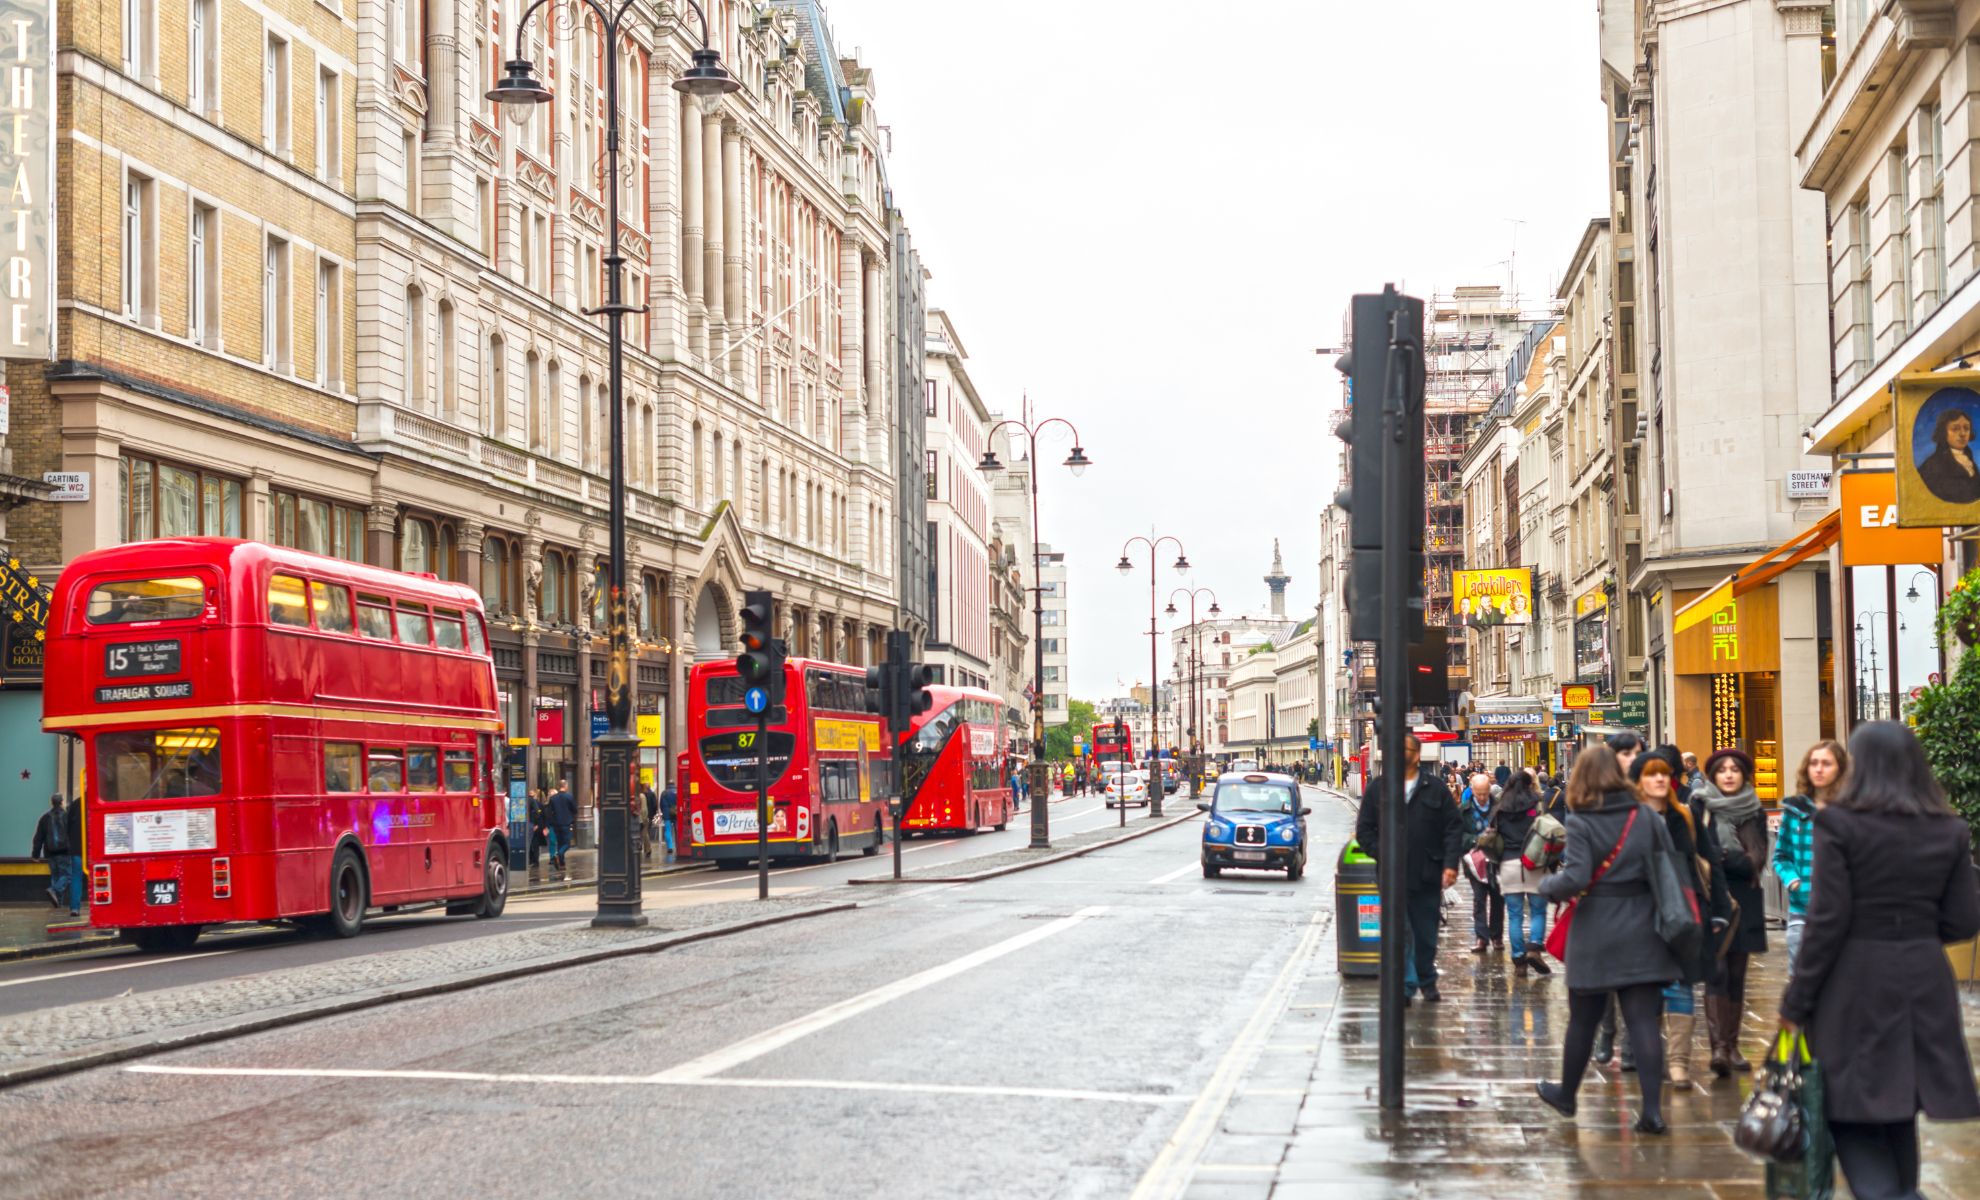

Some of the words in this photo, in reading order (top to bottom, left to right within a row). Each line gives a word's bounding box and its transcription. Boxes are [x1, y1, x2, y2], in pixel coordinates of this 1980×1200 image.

[10, 20, 33, 347] THEATRE
[47, 475, 79, 483] CARTING
[1792, 482, 1818, 490] STREET
[1462, 574, 1522, 597] Ladykillers
[1713, 624, 1736, 633] KIMCHEE
[13, 656, 43, 664] HOLE
[109, 648, 128, 671] 15
[101, 687, 151, 701] TRAFALGAR
[154, 684, 189, 697] SQUARE
[1566, 696, 1591, 704] BURGER
[539, 713, 548, 721] 85
[641, 725, 656, 734] itsu
[738, 733, 756, 747] 87
[915, 743, 923, 752] 9
[135, 814, 153, 824] VISIT
[153, 883, 175, 893] ALM
